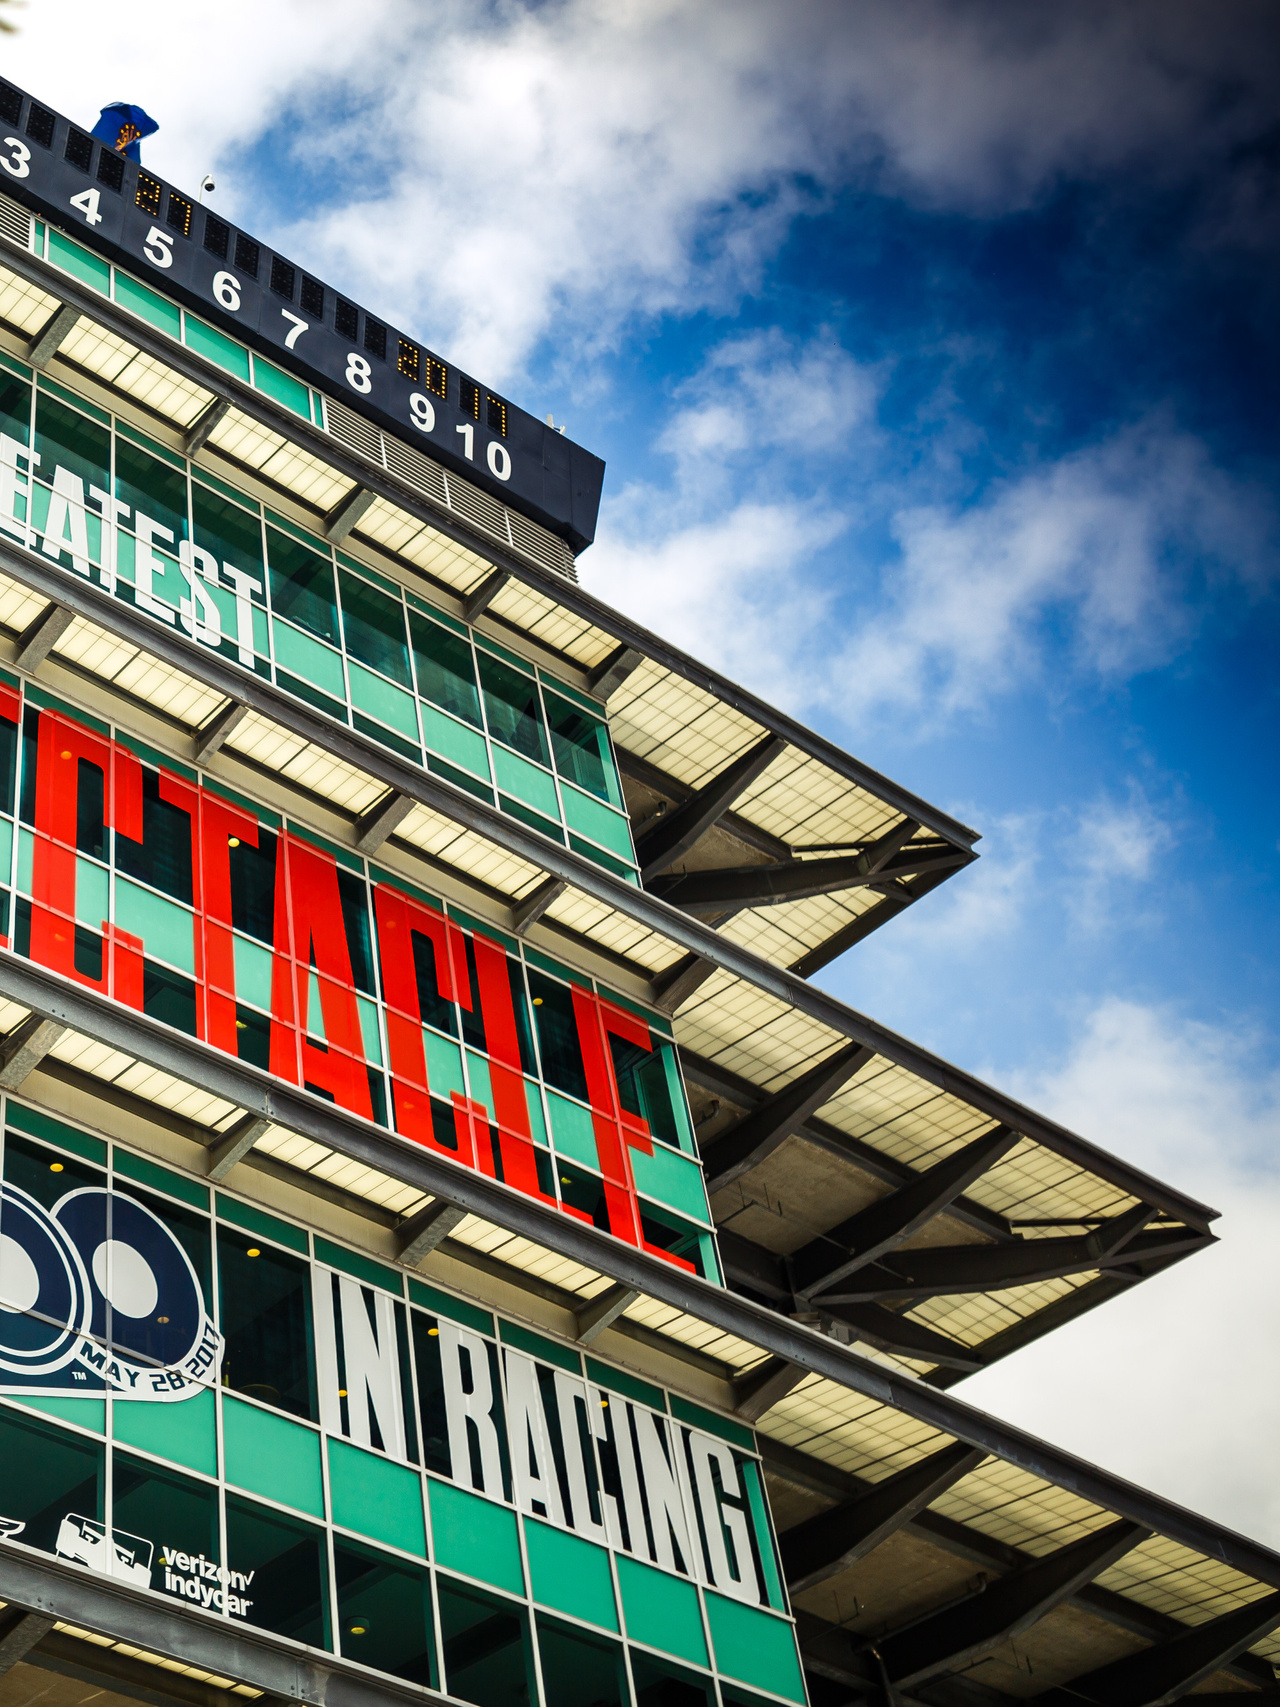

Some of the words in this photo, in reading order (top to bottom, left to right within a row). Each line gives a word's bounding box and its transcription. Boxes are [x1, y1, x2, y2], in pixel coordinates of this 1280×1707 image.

[0, 137, 31, 178] 3
[70, 188, 102, 226] 4
[135, 172, 193, 236] 27
[143, 226, 174, 268] 5
[212, 271, 242, 311] 6
[281, 308, 309, 349] 7
[345, 352, 372, 394] 8
[409, 392, 436, 433] 9
[456, 423, 512, 481] 10
[79, 1340, 141, 1387] MAY
[184, 1320, 221, 1379] 2017
[314, 1263, 408, 1464] IN
[437, 1318, 761, 1608] RACING
[162, 1545, 247, 1592] verizon
[164, 1566, 250, 1617] indycar
